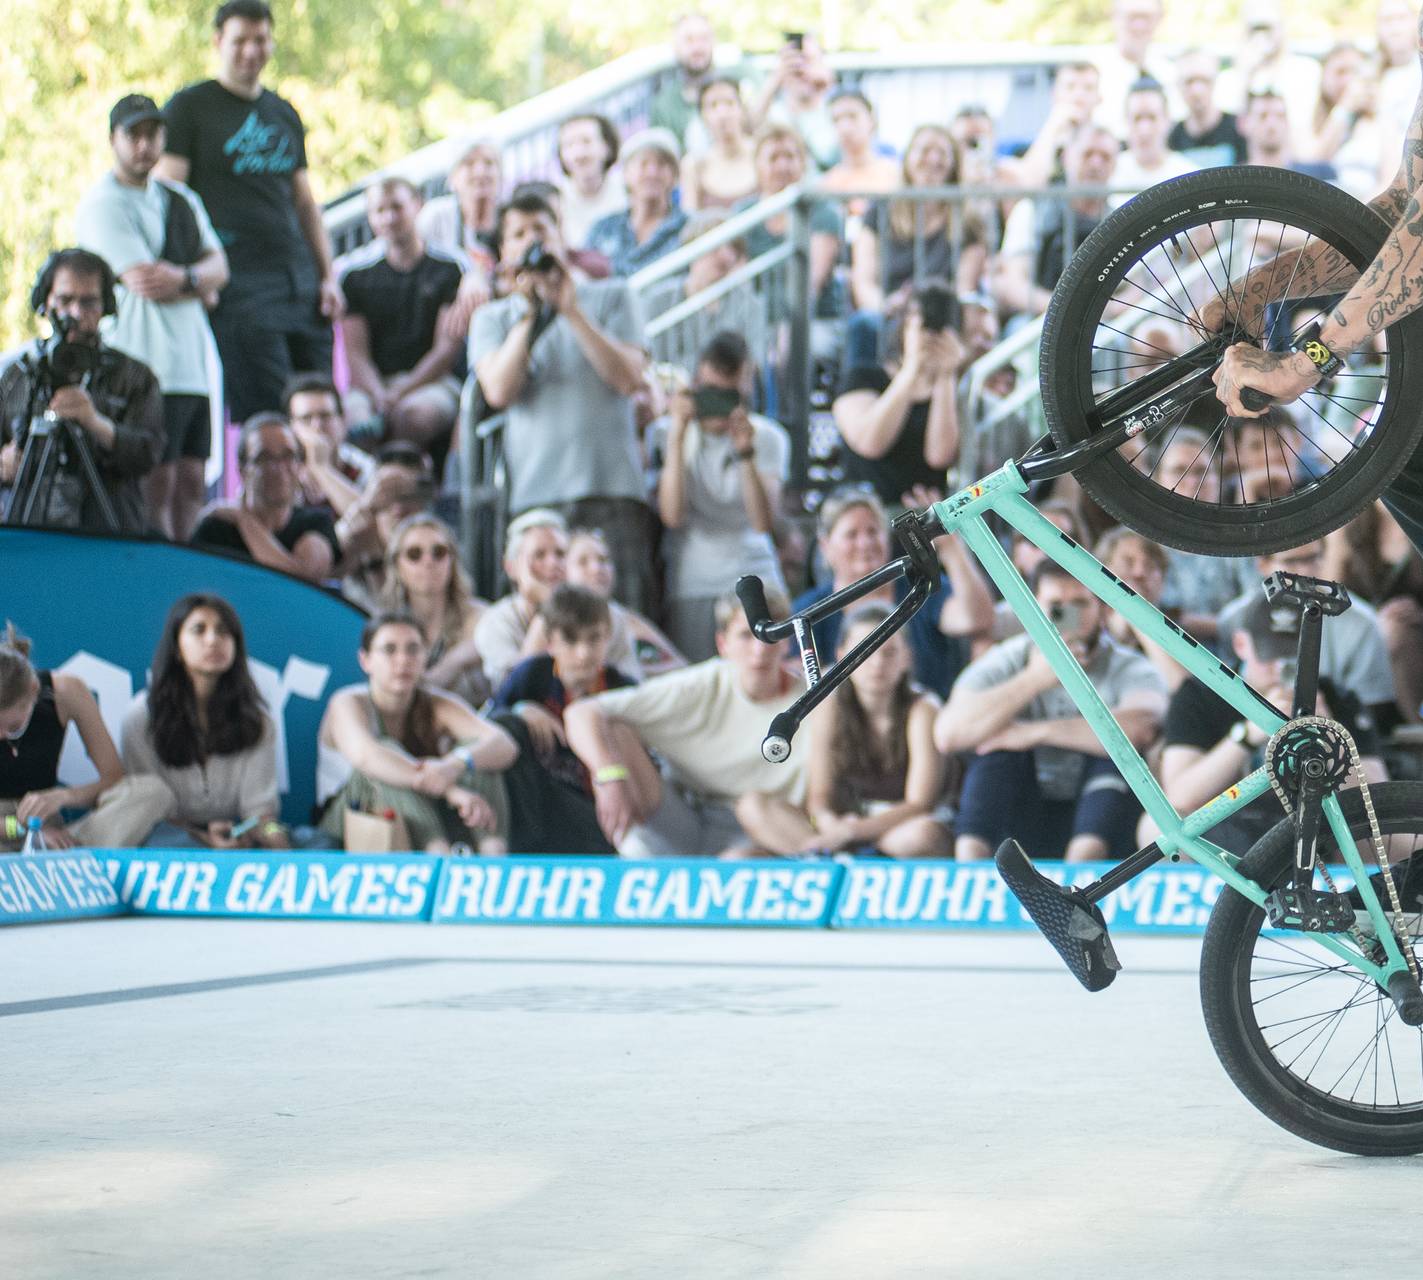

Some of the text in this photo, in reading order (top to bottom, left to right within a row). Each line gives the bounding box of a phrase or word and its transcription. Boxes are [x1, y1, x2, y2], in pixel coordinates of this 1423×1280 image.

[1097, 240, 1135, 282] ODYSSEY
[224, 863, 432, 917] GAMES
[440, 863, 828, 921] RUHR GAMES
[839, 866, 1009, 922] RUHR
